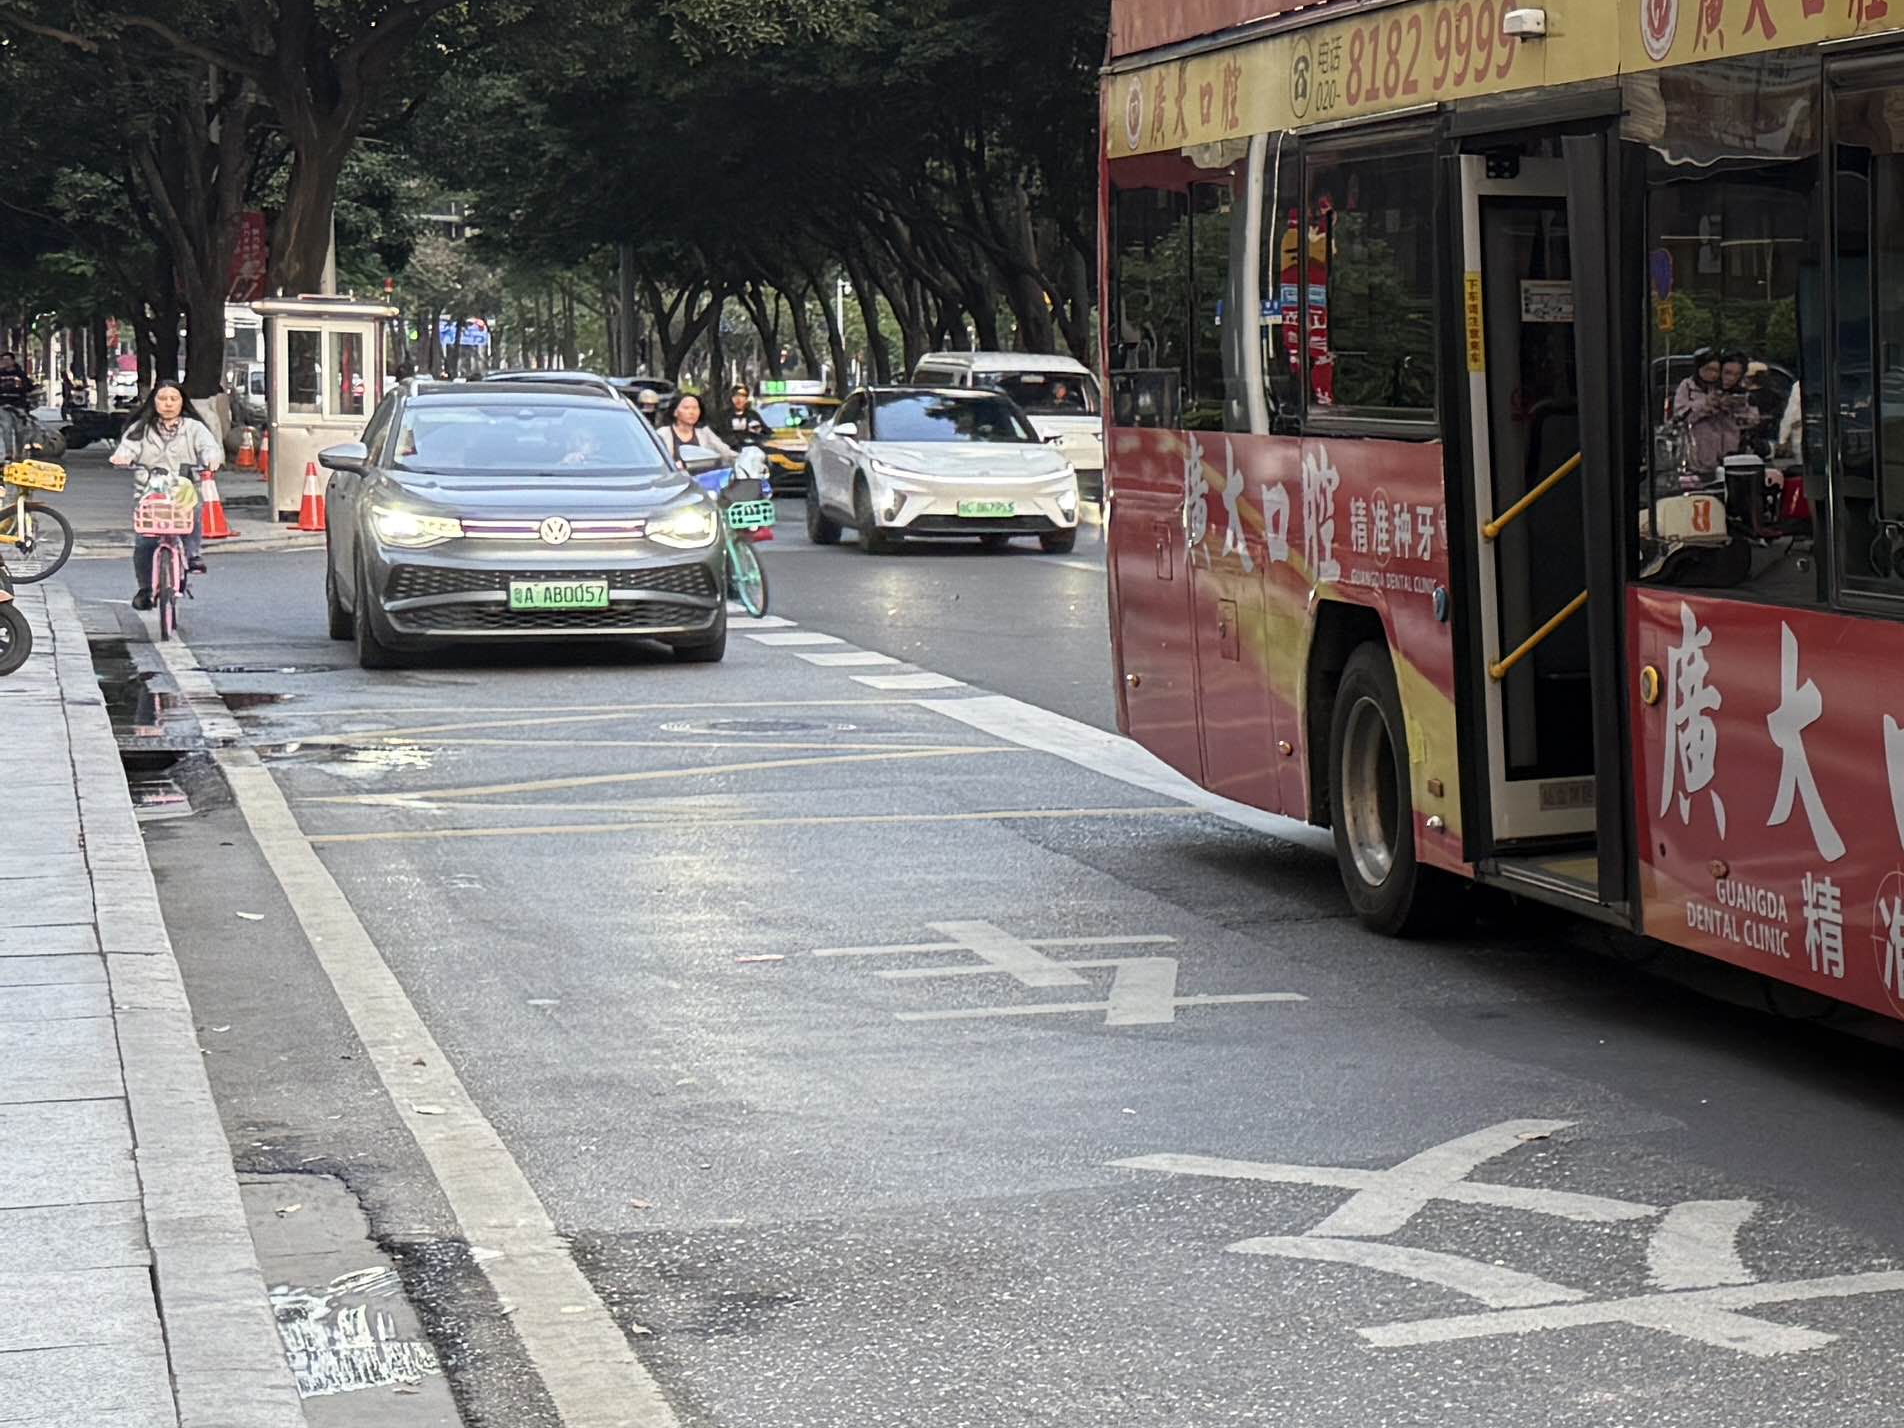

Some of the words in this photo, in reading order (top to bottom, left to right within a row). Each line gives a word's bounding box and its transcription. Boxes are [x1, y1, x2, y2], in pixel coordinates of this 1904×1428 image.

[1315, 80, 1341, 112] 020-
[1346, 13, 1423, 107] 8182
[1318, 36, 1344, 74] 电话
[1150, 53, 1243, 146] 廣大口腔
[1183, 430, 1342, 582] 廣大口腔
[1350, 496, 1435, 561] 精准种牙
[1686, 901, 1740, 943] DENTAL
[1743, 919, 1791, 959] CLINIC
[1716, 878, 1789, 924] GUANGDA
